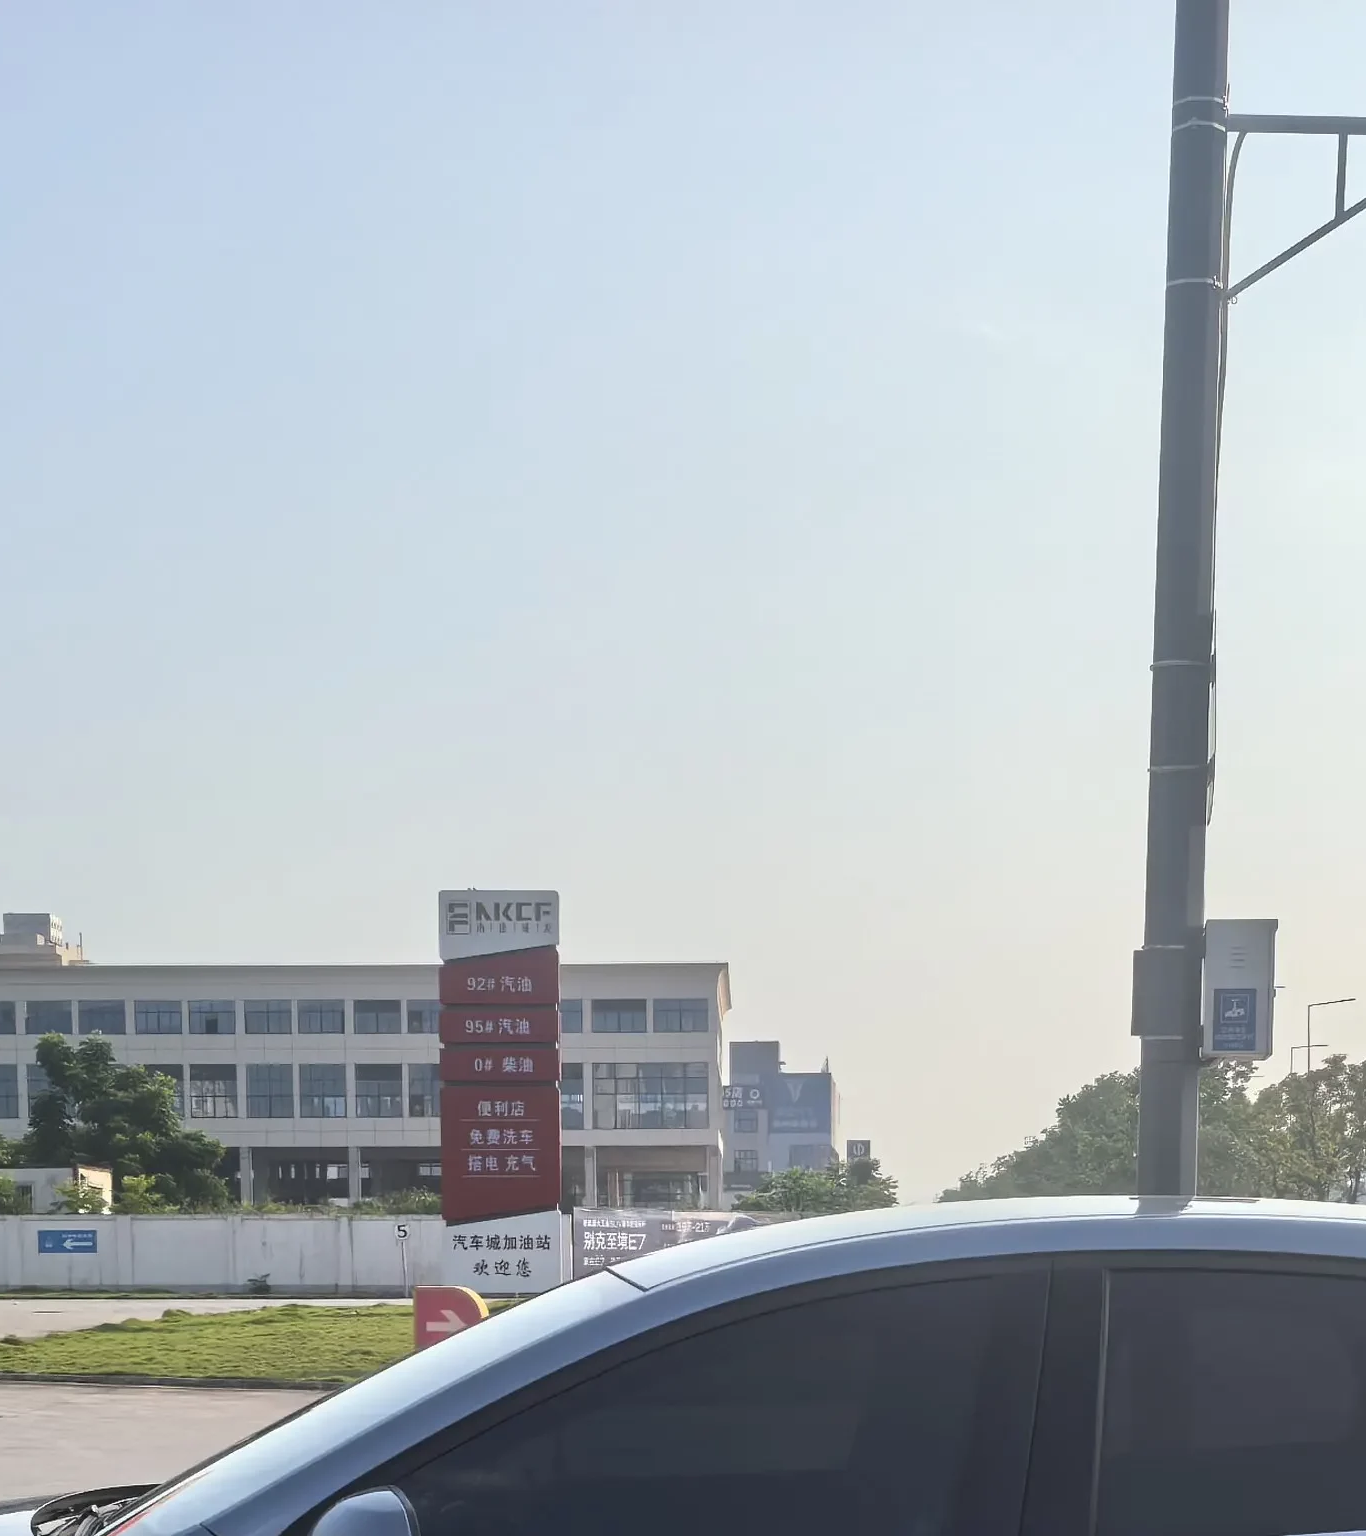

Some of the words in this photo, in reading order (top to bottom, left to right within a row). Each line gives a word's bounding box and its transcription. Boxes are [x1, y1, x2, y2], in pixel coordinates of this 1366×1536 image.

[467, 977, 495, 991] 92#
[500, 976, 532, 992] 汽油
[465, 1019, 494, 1034] 95#
[498, 1018, 530, 1035] 汽油
[475, 1057, 493, 1072] 0#
[502, 1056, 533, 1073] 柴油
[478, 1100, 525, 1117] 便利店
[470, 1128, 534, 1145] 免费洗车
[468, 1155, 499, 1172] 搭电
[505, 1155, 536, 1172] 充气
[397, 1224, 407, 1238] 5
[452, 1234, 551, 1251] 汽车城加油站
[583, 1231, 646, 1250] 别克至境E7
[473, 1258, 532, 1277] 欢迎您
